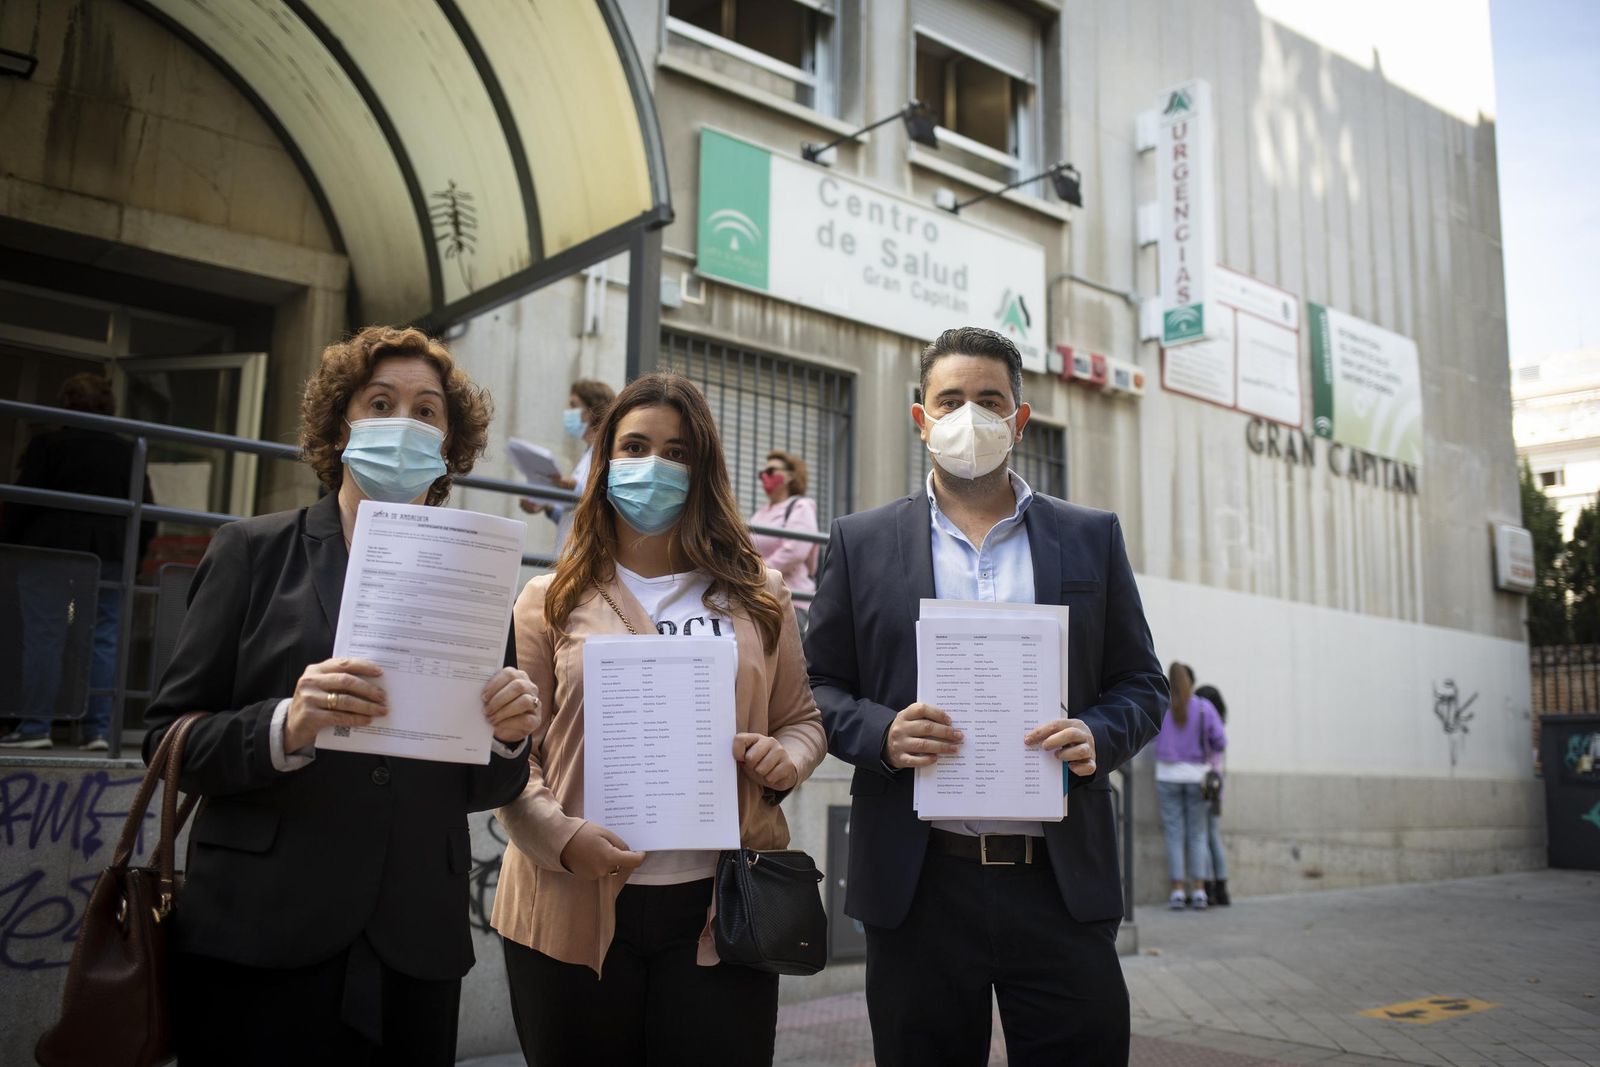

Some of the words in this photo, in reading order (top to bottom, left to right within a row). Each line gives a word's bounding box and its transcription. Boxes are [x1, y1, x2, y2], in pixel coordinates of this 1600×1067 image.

[818, 175, 939, 243] Centro
[1171, 121, 1191, 305] URGENCIAS
[817, 220, 857, 256] de
[881, 237, 969, 292] Salud
[862, 265, 902, 293] Gran
[1245, 416, 1316, 468] GRAN
